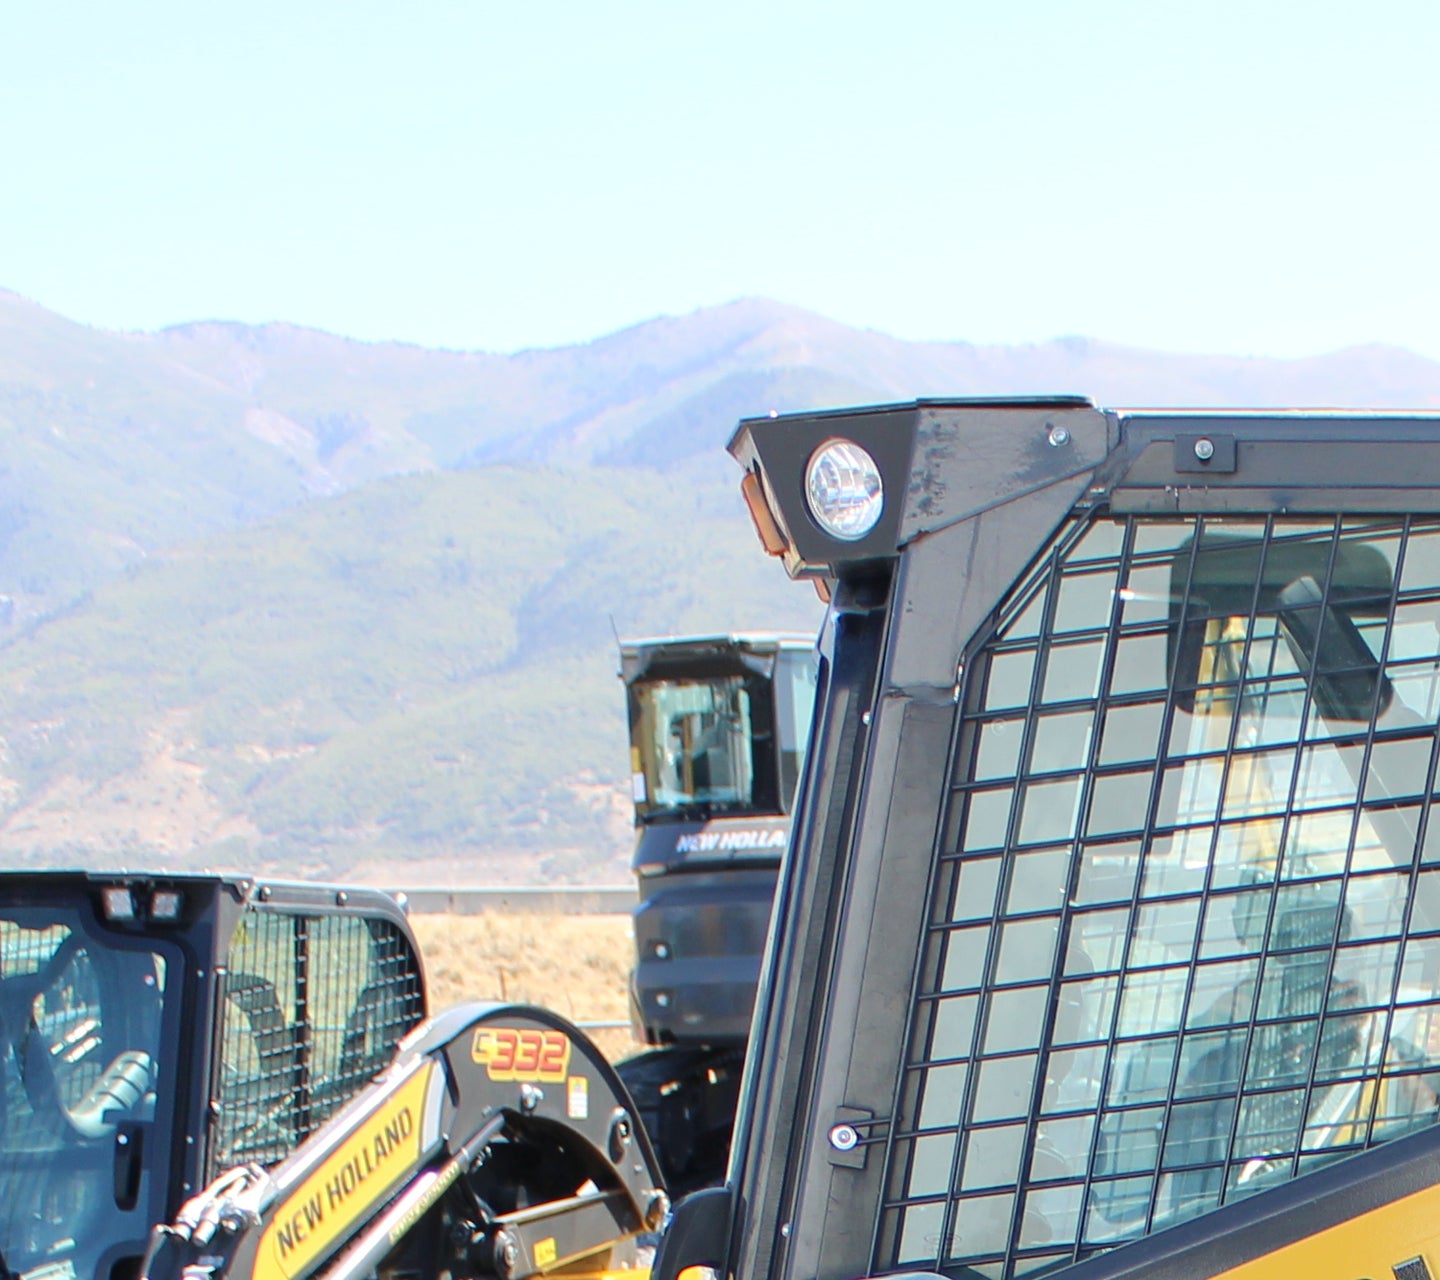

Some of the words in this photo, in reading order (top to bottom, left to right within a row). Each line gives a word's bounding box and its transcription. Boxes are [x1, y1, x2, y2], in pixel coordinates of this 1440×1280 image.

[719, 829, 787, 849] HOLLA
[276, 1191, 324, 1258] NEW
[325, 1106, 413, 1210] HOLLAND
